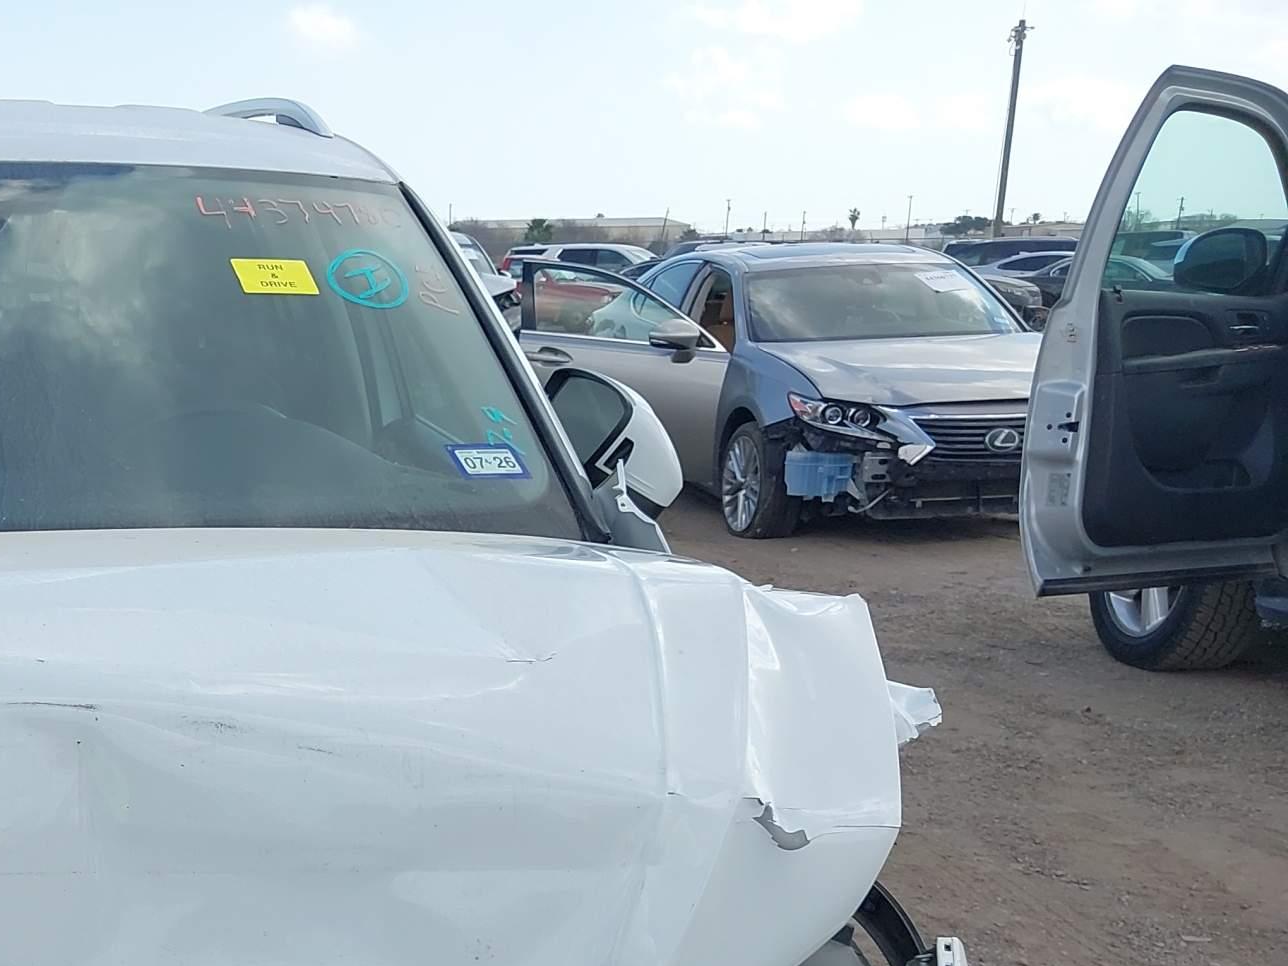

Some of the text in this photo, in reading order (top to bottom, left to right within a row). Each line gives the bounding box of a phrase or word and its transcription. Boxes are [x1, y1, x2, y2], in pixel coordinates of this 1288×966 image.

[256, 262, 285, 273] RUN
[258, 279, 298, 289] DRIVE
[463, 456, 517, 469] 07 26
